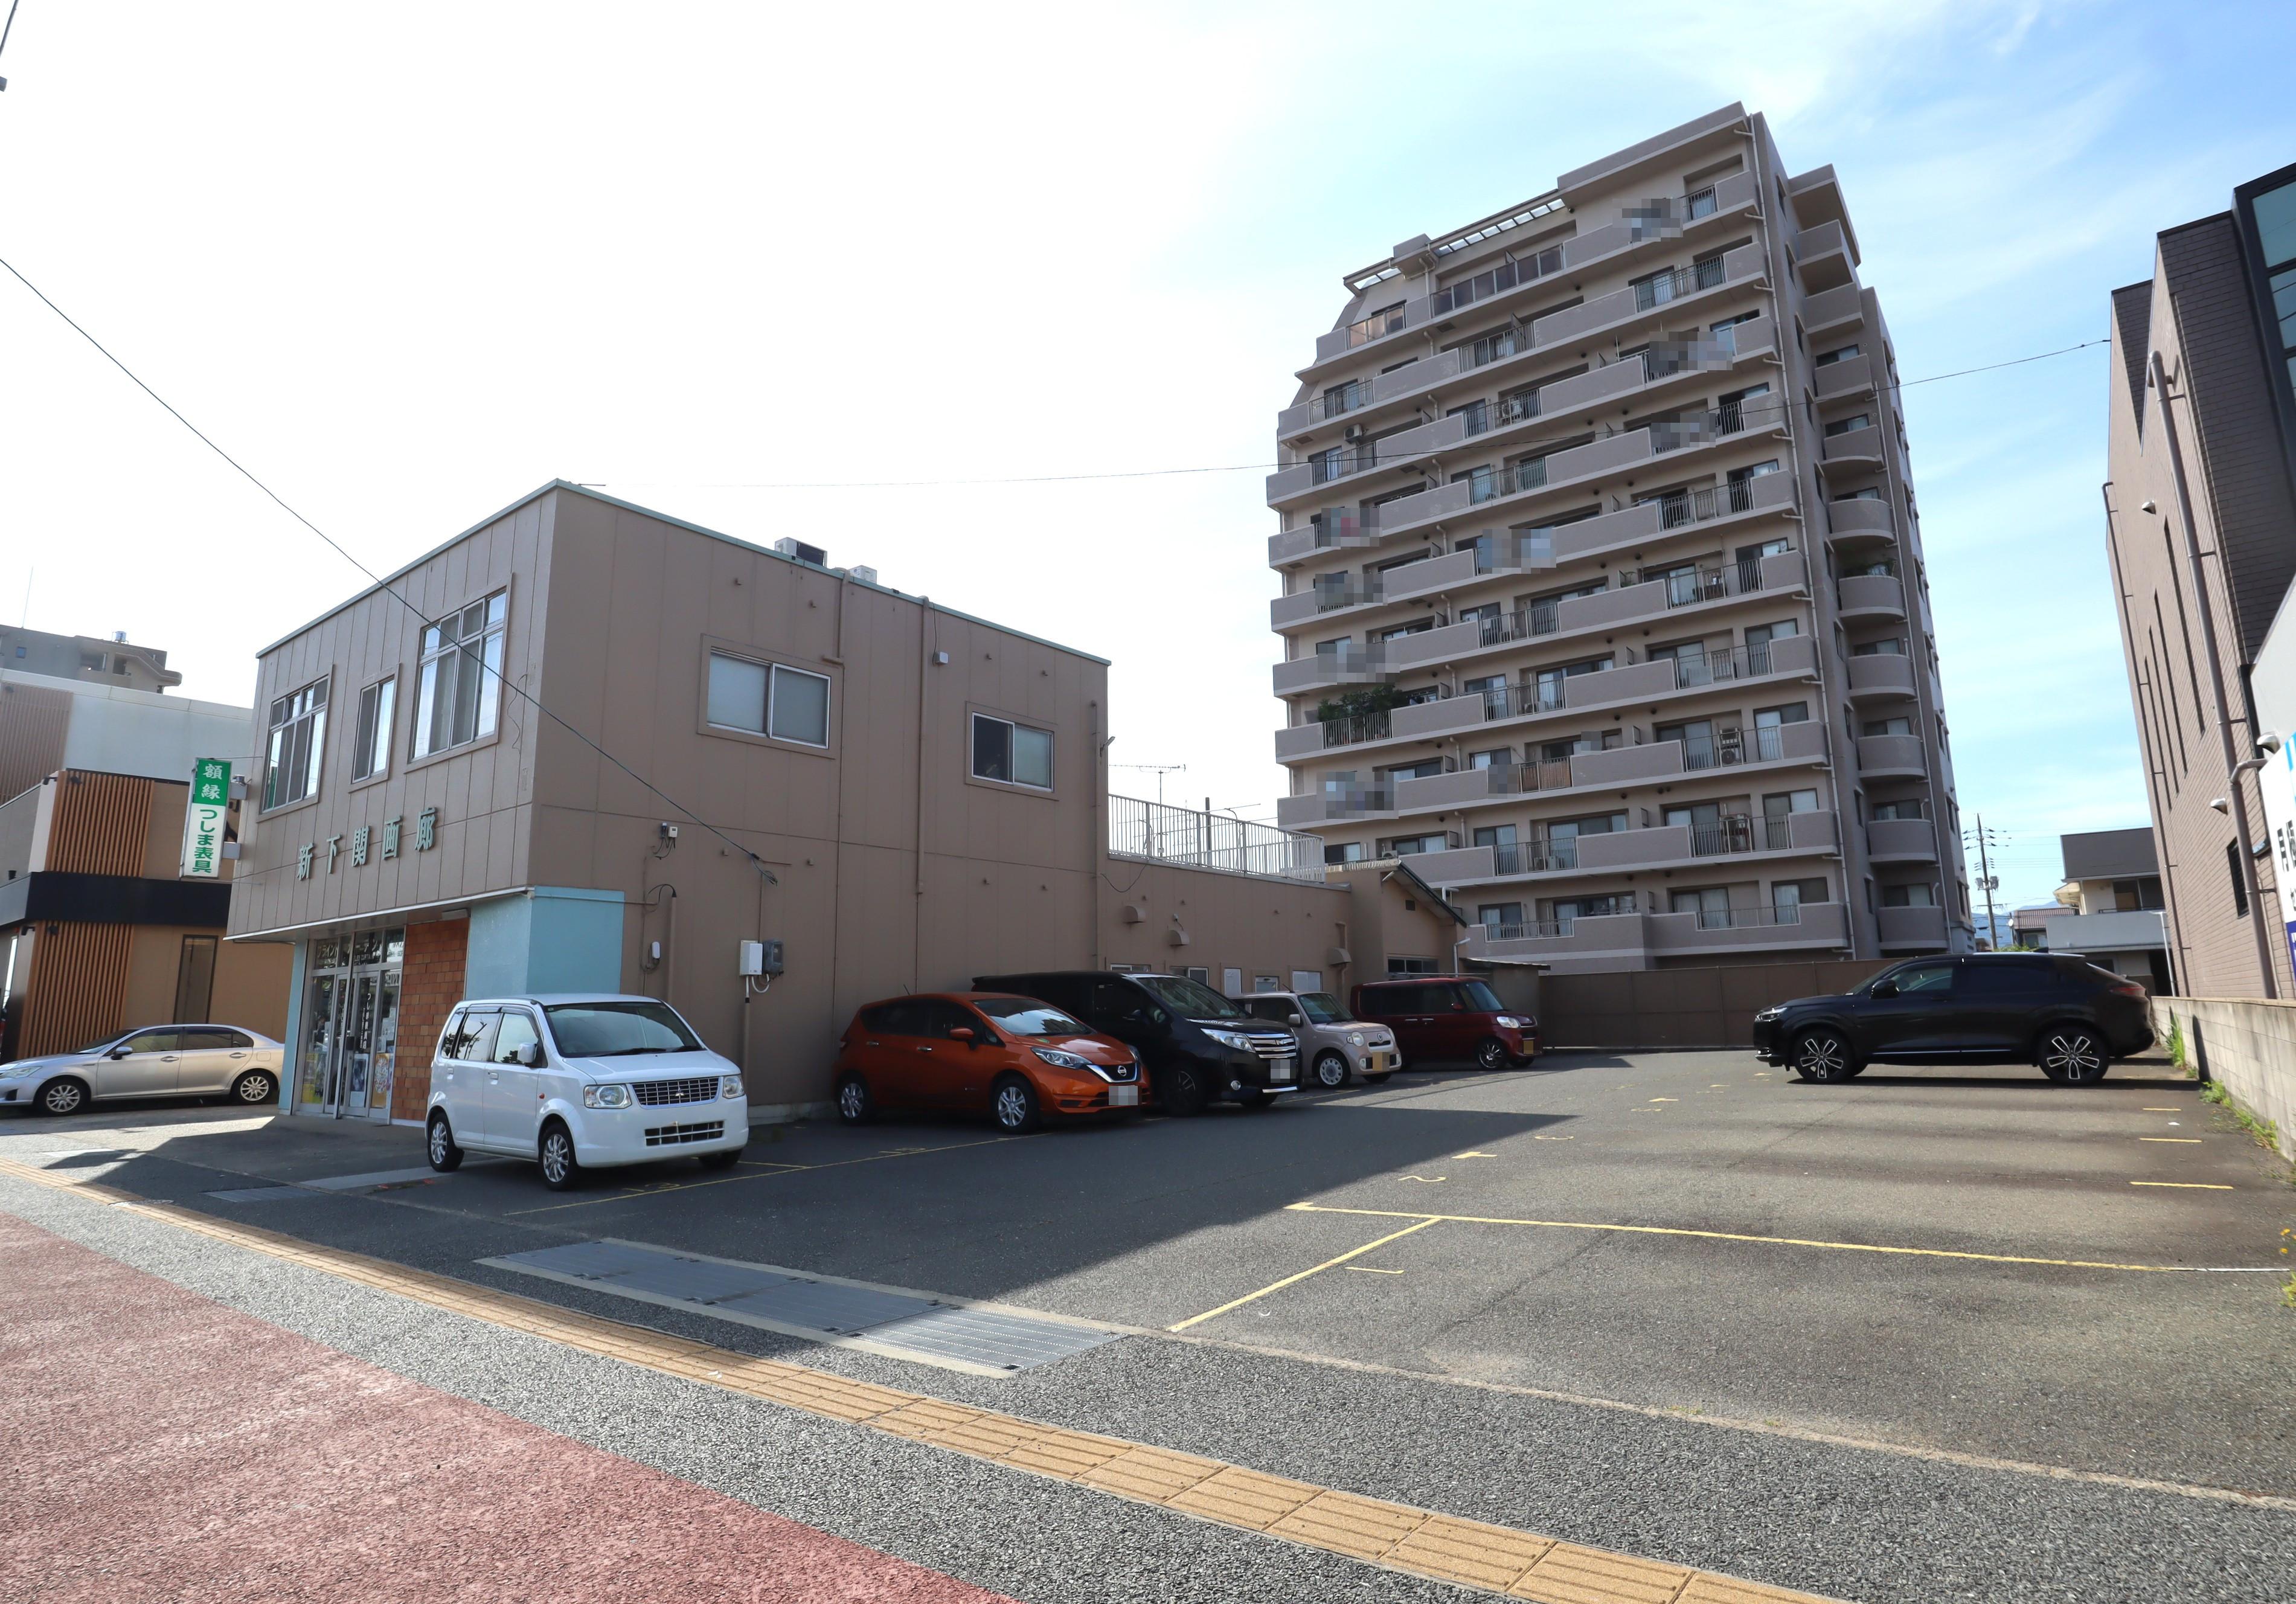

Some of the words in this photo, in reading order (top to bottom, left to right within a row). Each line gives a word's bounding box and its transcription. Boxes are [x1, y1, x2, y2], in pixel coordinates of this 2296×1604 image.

[201, 763, 222, 800] 額縁
[192, 809, 217, 873] つしま表具
[297, 807, 437, 881] 新下関画廊
